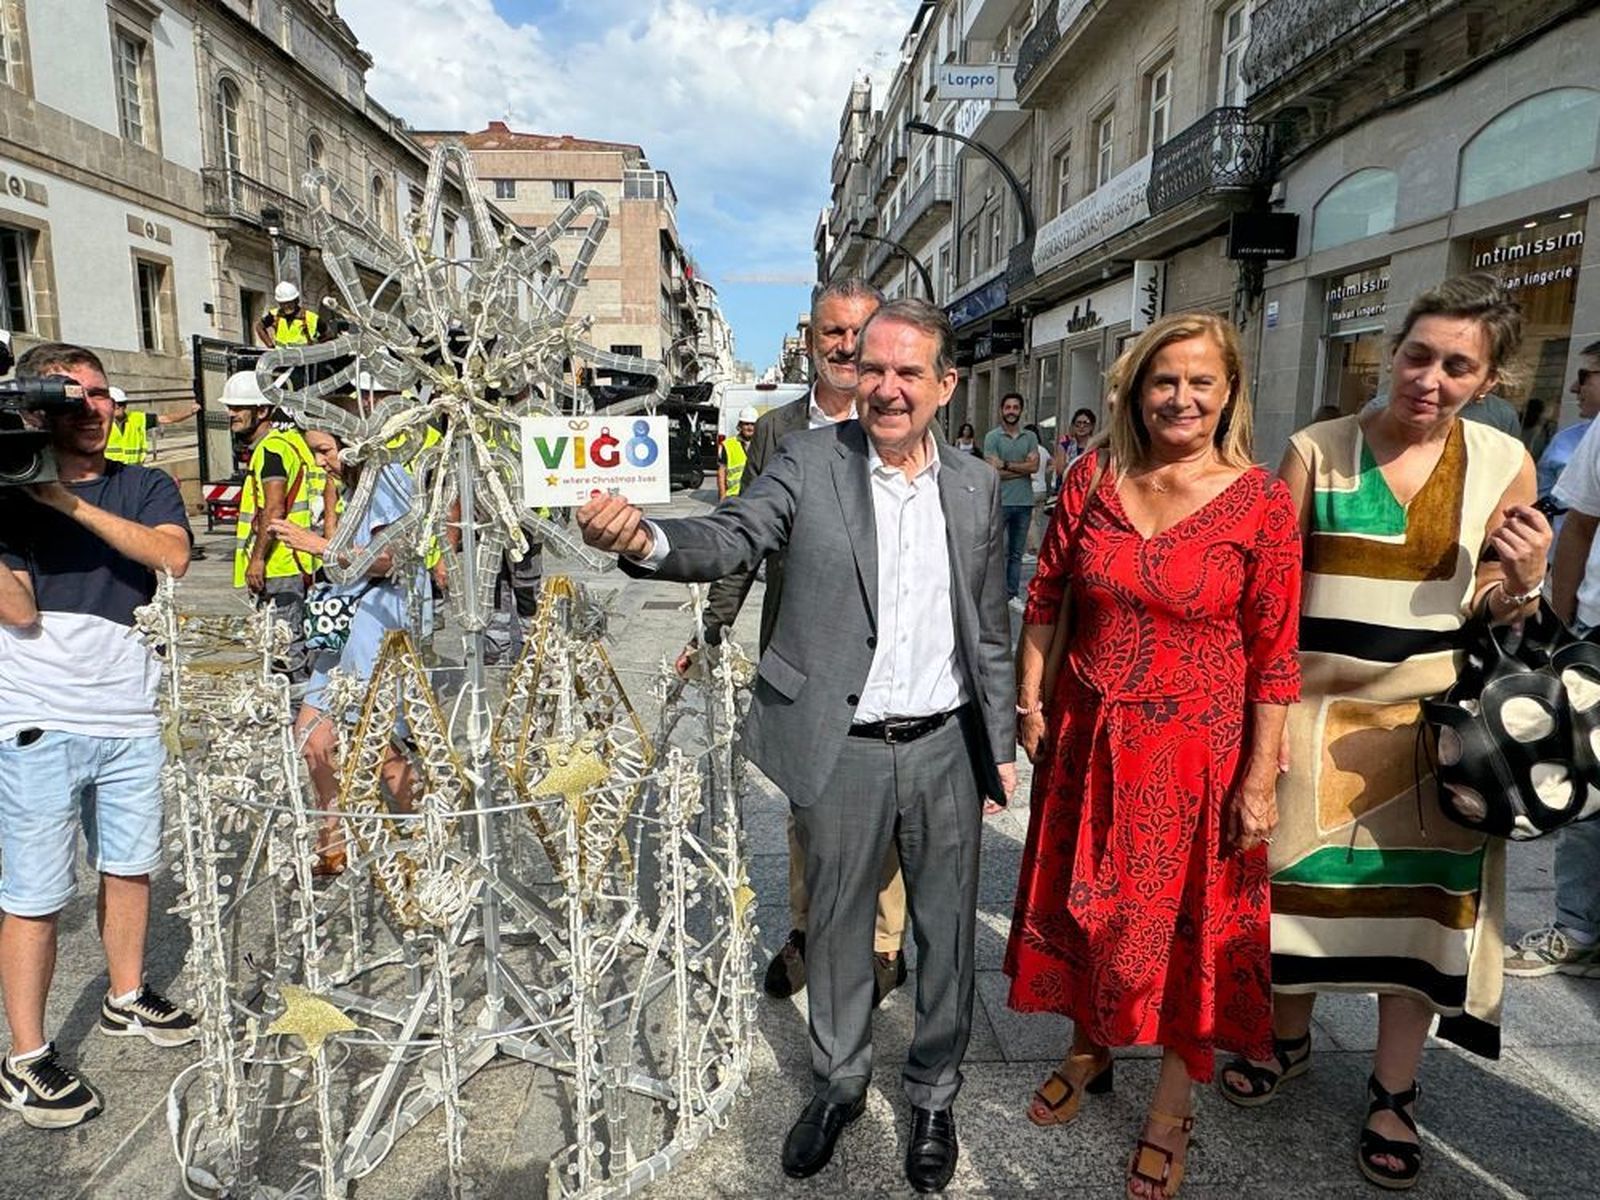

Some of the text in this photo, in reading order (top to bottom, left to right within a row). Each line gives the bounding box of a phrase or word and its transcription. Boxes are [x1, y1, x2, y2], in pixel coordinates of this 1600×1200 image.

[948, 72, 995, 89] Larpro
[1475, 230, 1584, 268] intimissim
[1523, 265, 1574, 286] lingerie
[591, 474, 636, 485] Christmas
